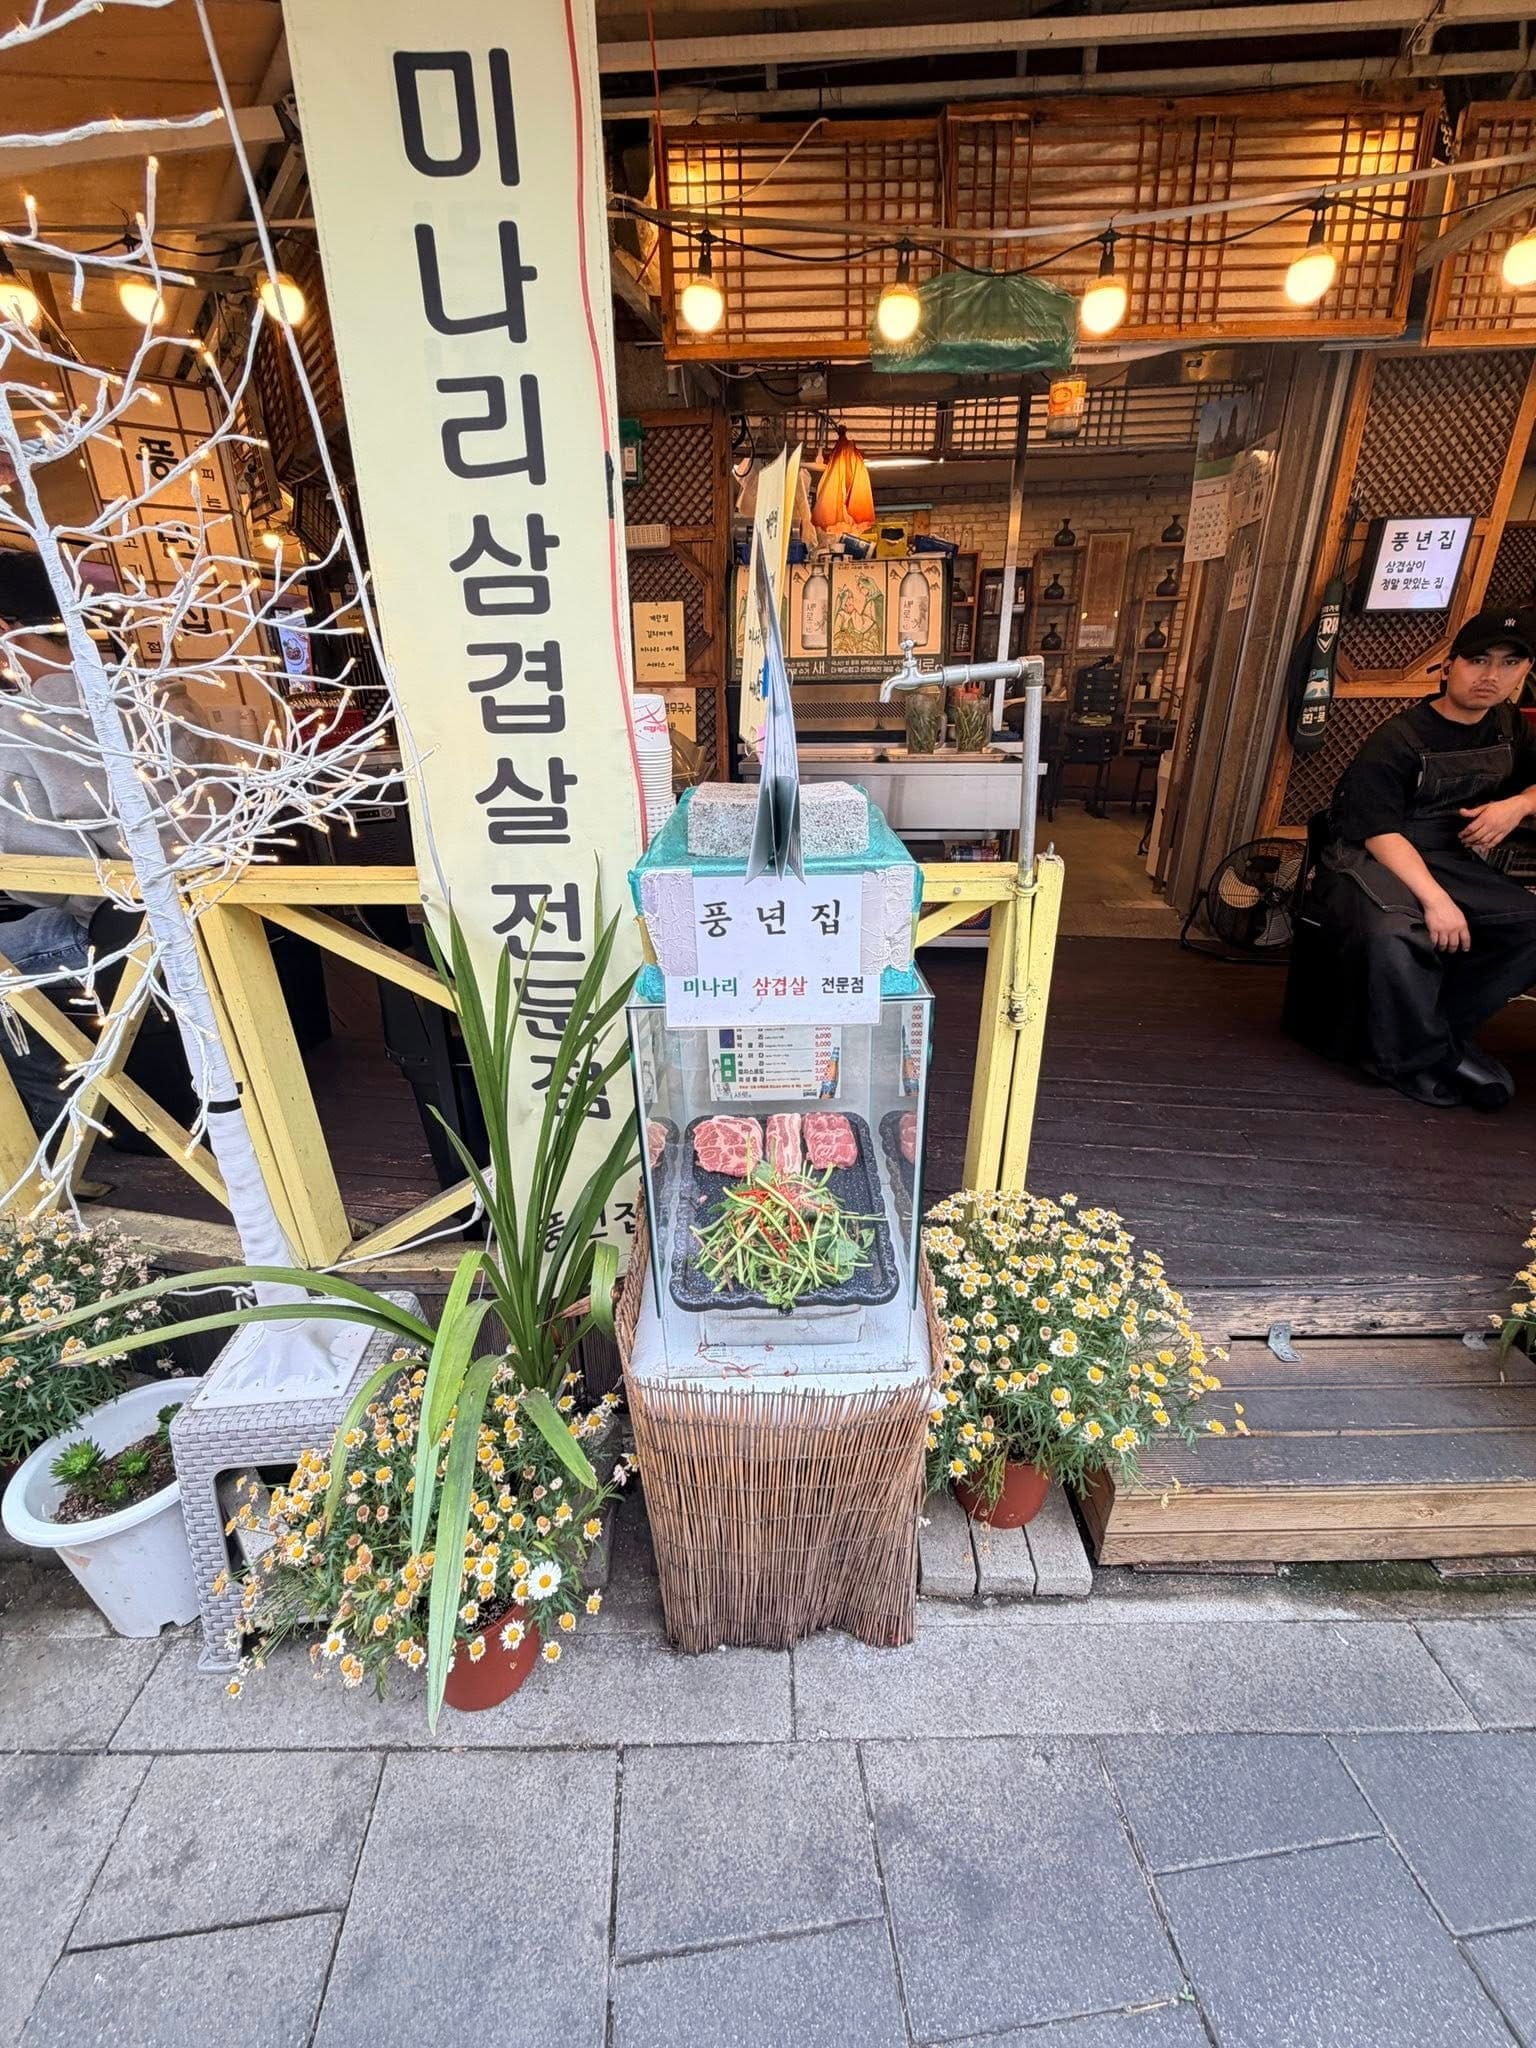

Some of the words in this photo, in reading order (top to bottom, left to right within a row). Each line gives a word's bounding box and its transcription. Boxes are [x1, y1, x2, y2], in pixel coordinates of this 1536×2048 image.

[1384, 560, 1426, 574] 삼겹살이
[1380, 577, 1401, 591] 정말
[1402, 577, 1431, 591] 맛있는
[1433, 576, 1445, 590] 집
[683, 977, 738, 998] 미나리
[752, 976, 808, 996] 삼겹살
[821, 976, 865, 994] 전문점
